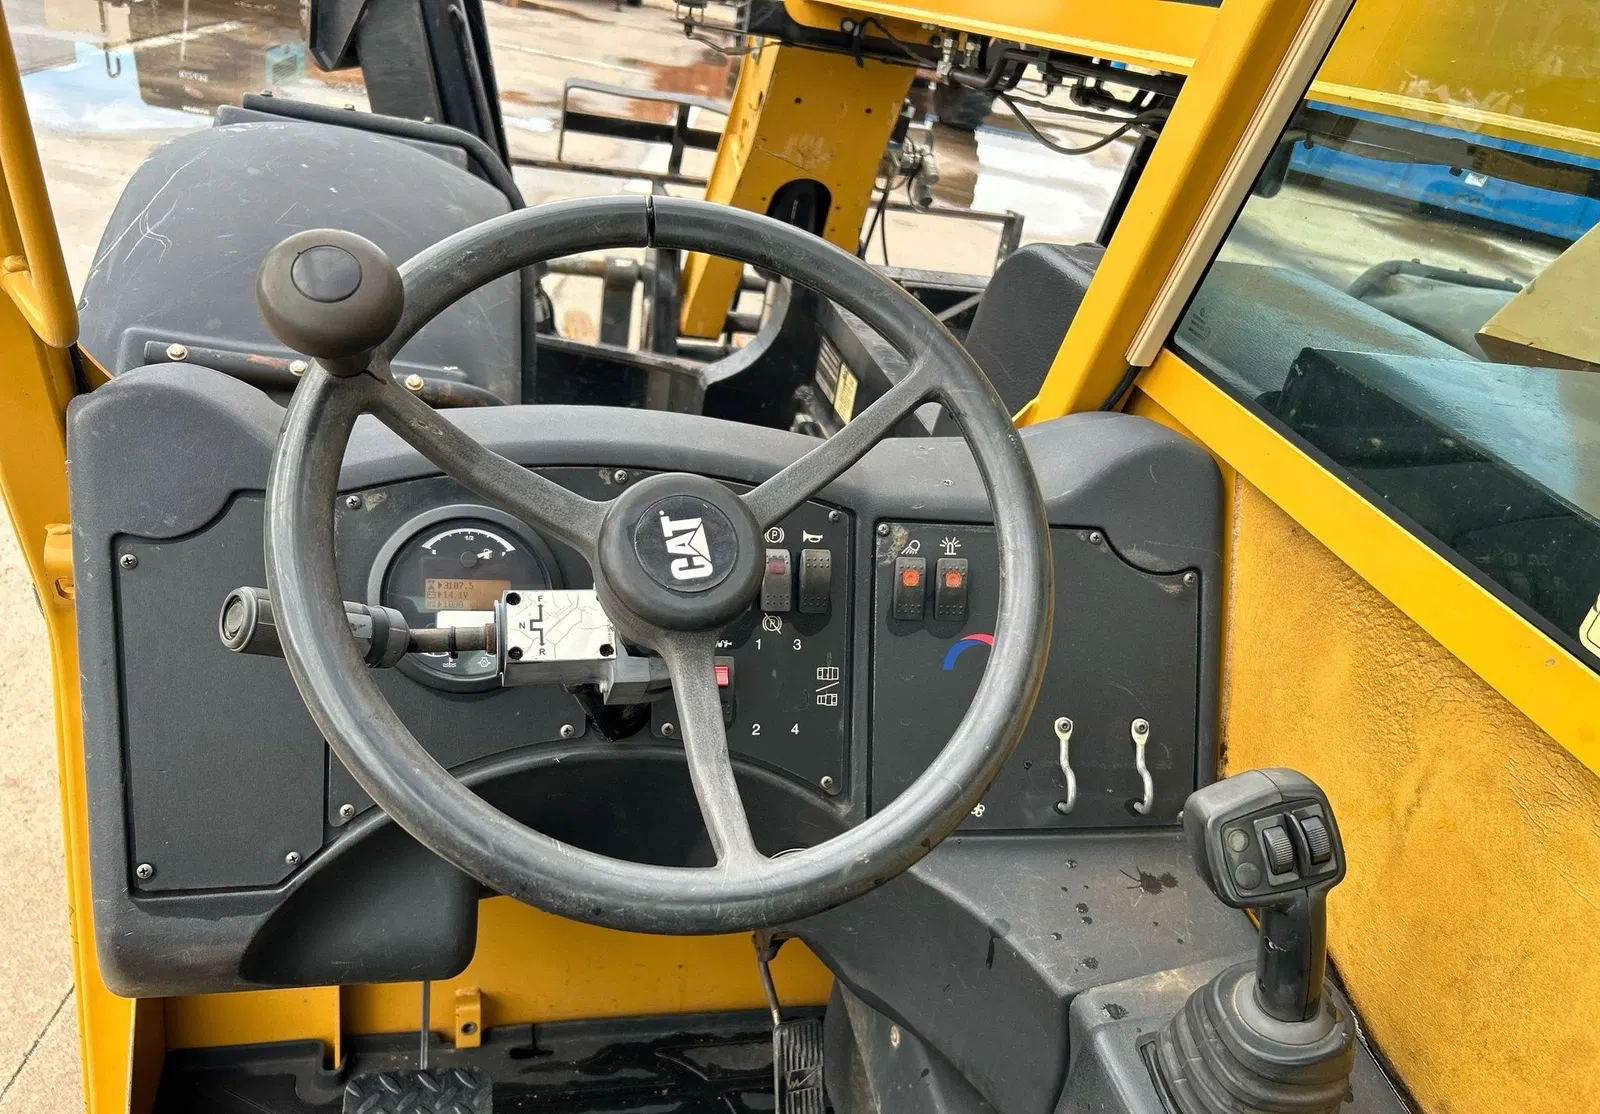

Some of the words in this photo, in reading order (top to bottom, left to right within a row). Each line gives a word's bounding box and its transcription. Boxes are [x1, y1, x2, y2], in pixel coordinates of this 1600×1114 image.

[660, 514, 714, 580] CAT
[443, 591, 469, 600] 14.1V
[755, 638, 761, 650] 1
[792, 638, 802, 651] 3
[539, 648, 546, 656] R
[751, 723, 761, 736] 2
[790, 723, 800, 735] 4
